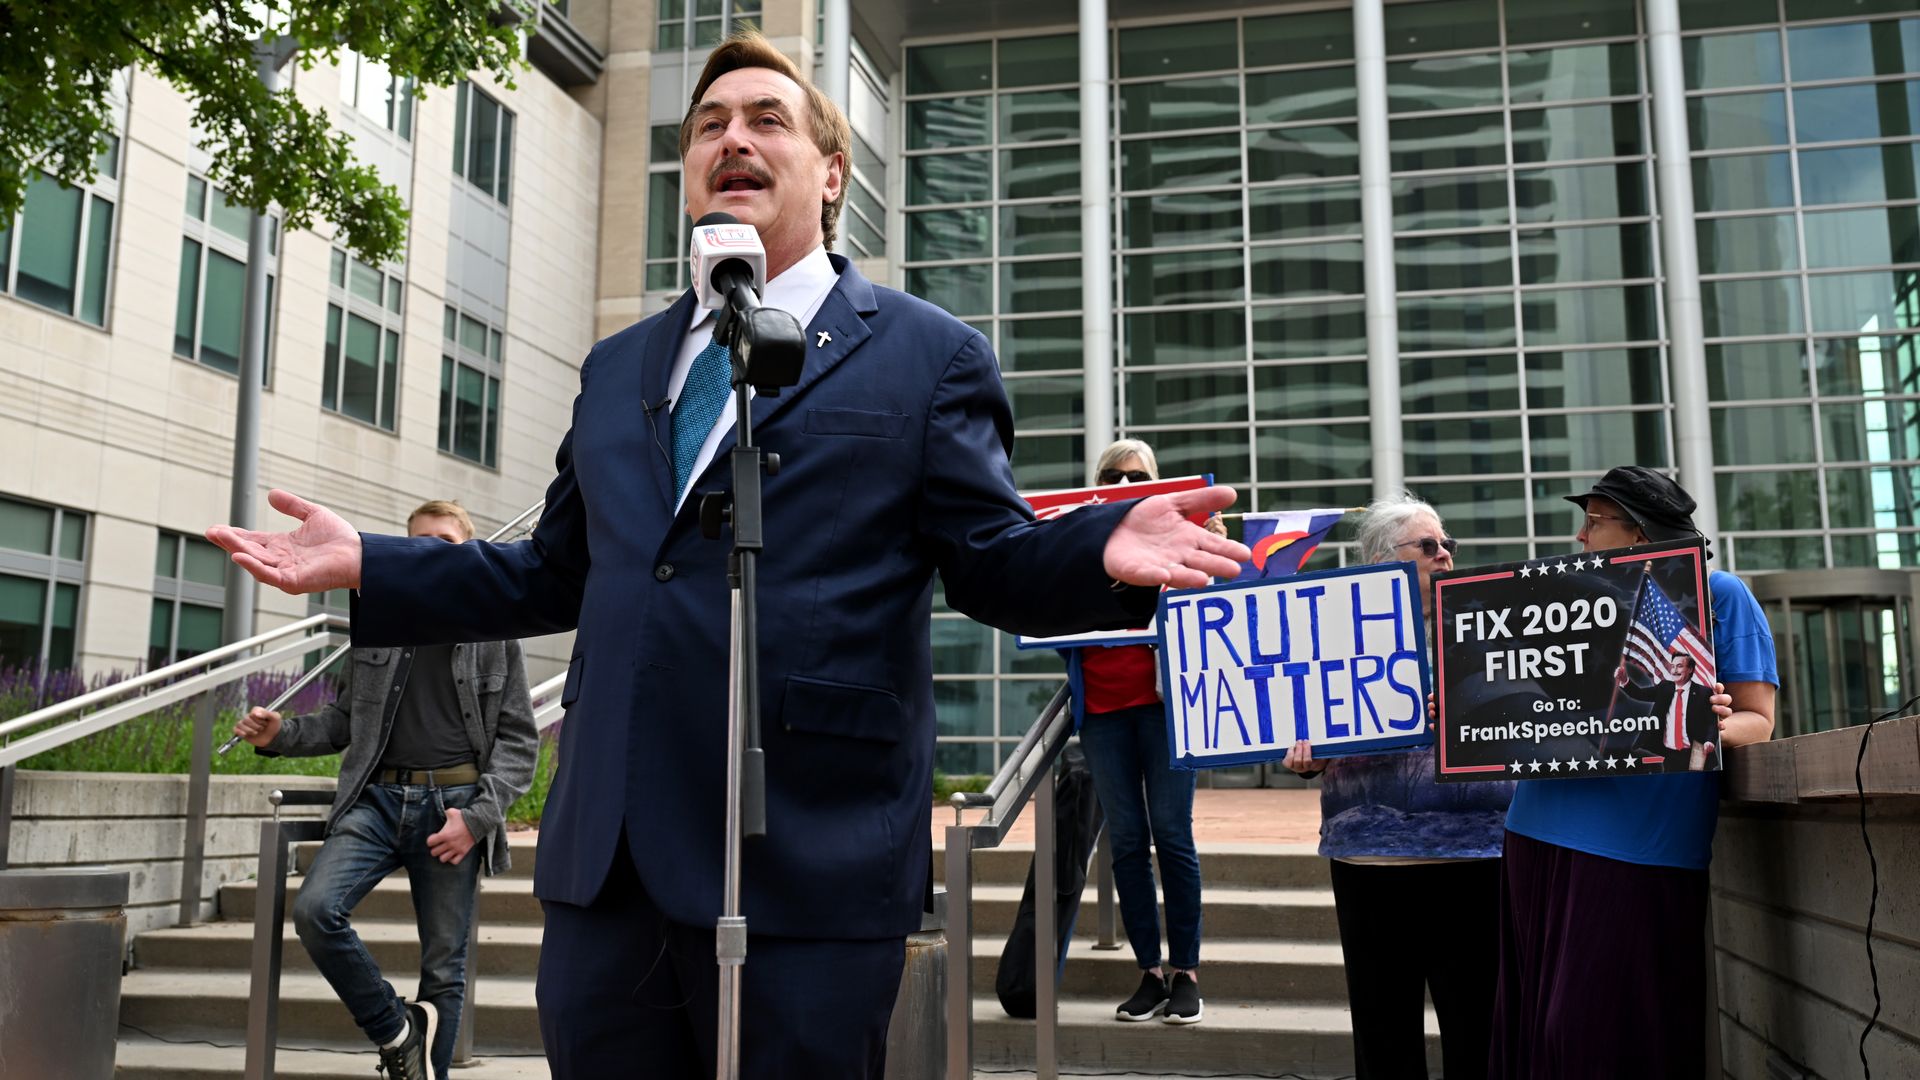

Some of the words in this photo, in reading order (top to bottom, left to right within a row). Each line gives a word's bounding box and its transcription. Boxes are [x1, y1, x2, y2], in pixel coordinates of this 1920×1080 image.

[1167, 578, 1404, 673] TRUTH
[1455, 607, 1513, 643] FIX
[1522, 596, 1617, 636] 2020
[1485, 642, 1590, 682] FIRST
[1179, 650, 1421, 751] MATTERS
[1532, 700, 1555, 713] Go
[1557, 698, 1581, 712] To:
[1460, 715, 1660, 743] FrankSpeech.com
